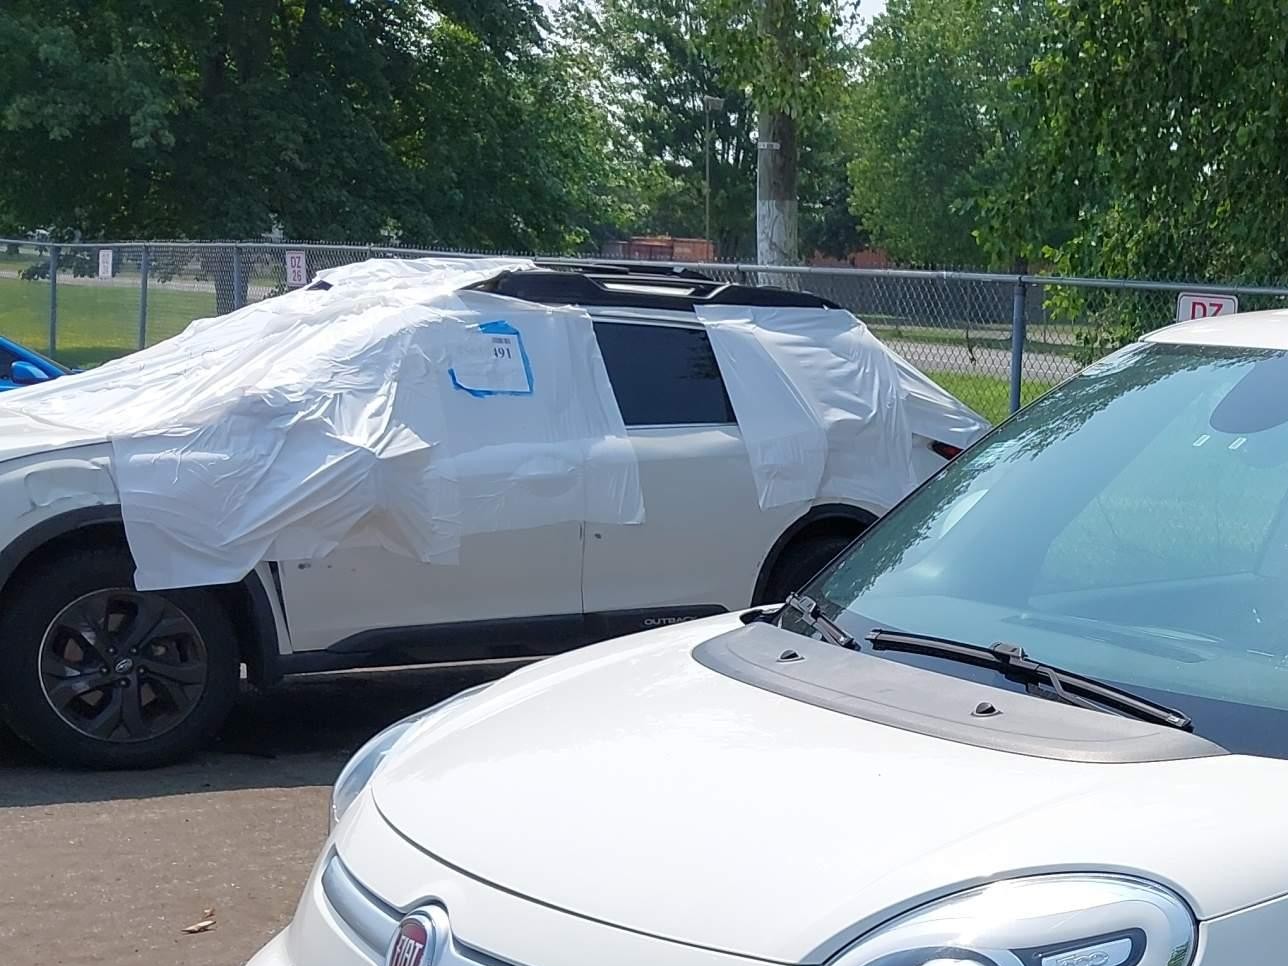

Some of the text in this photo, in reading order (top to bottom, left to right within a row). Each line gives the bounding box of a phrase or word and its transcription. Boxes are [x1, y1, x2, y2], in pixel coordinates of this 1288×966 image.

[290, 255, 302, 269] DZ
[292, 269, 303, 283] 26
[1191, 301, 1224, 320] DZ
